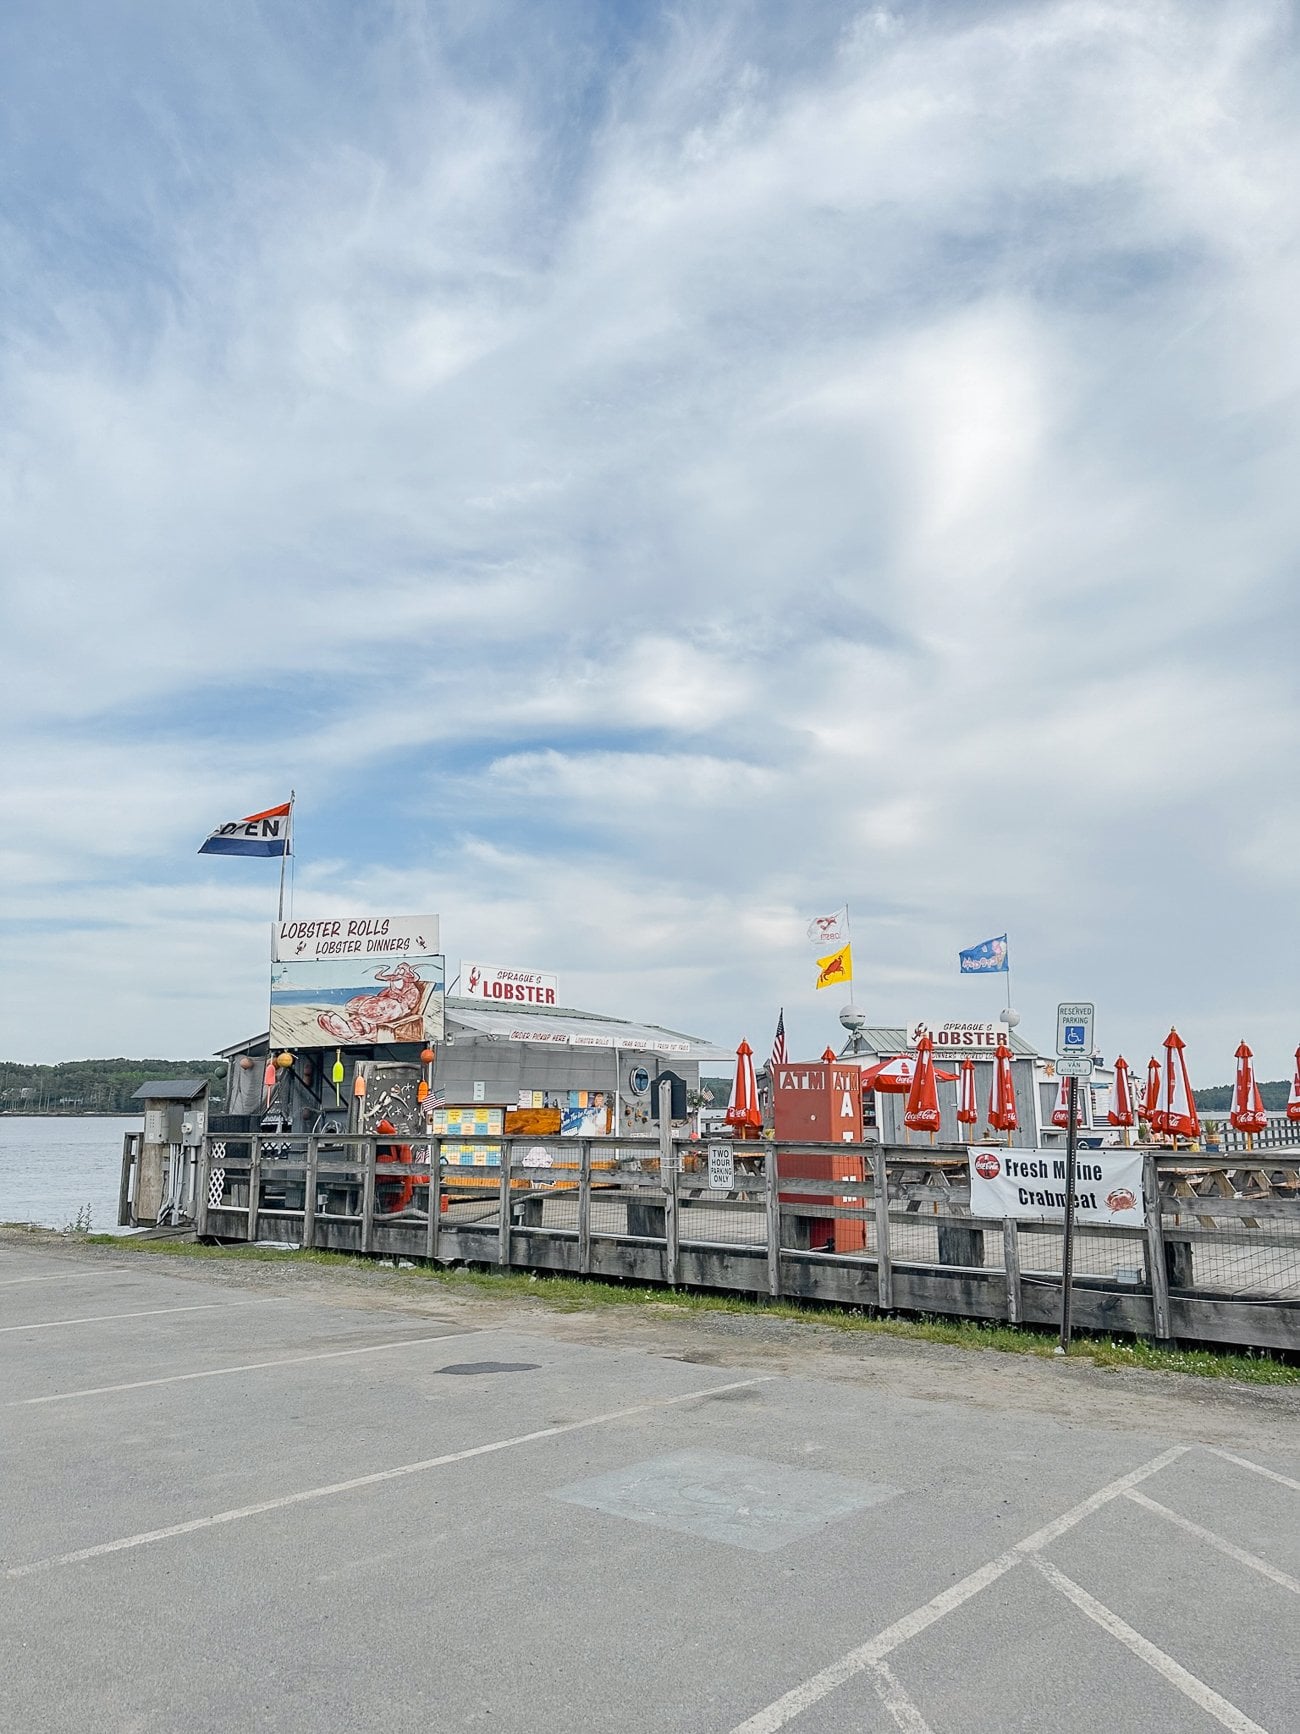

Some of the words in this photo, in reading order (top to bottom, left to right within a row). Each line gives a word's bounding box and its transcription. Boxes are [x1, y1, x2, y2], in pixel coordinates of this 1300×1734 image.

[280, 921, 341, 939] LOBSTER
[347, 918, 390, 937] ROLLS
[315, 939, 362, 954] LOBSTER
[366, 937, 411, 953] DINNERS
[483, 980, 555, 1004] LOBSTER
[1060, 1007, 1092, 1015] RESERVED
[929, 1032, 1008, 1046] LOBSTER
[780, 1071, 824, 1090] ATM
[833, 1071, 859, 1091] ATM
[712, 1149, 730, 1158] TWO
[711, 1158, 731, 1167] HOUR
[1005, 1158, 1048, 1179] Fresh
[1053, 1160, 1103, 1181] Mine
[711, 1167, 732, 1175] PARKING
[713, 1174, 730, 1183] ONLY
